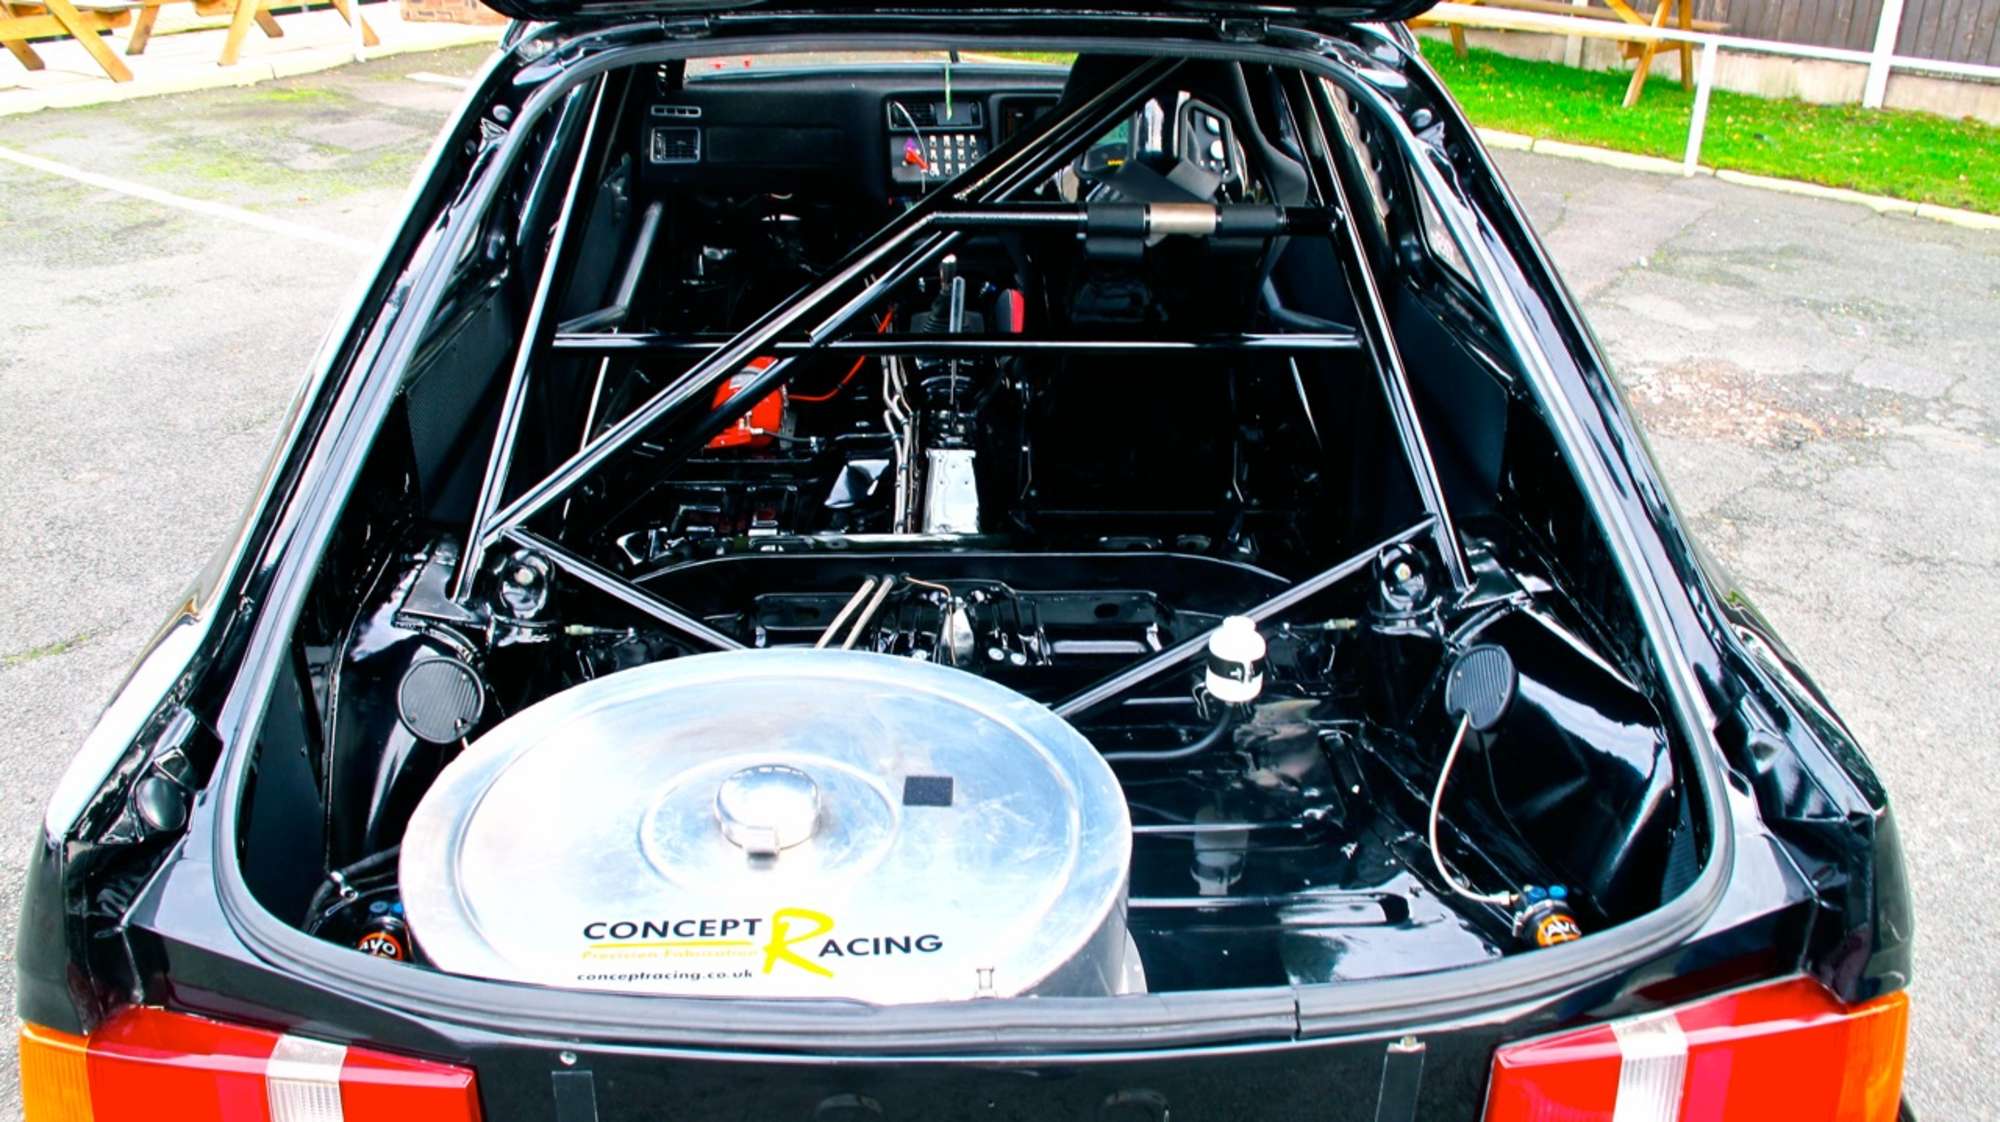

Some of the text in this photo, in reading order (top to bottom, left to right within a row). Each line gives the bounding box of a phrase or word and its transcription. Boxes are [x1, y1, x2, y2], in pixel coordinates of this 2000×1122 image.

[583, 907, 943, 978] CONCEPT RACING
[577, 969, 753, 982] conceptracing.co.uk
